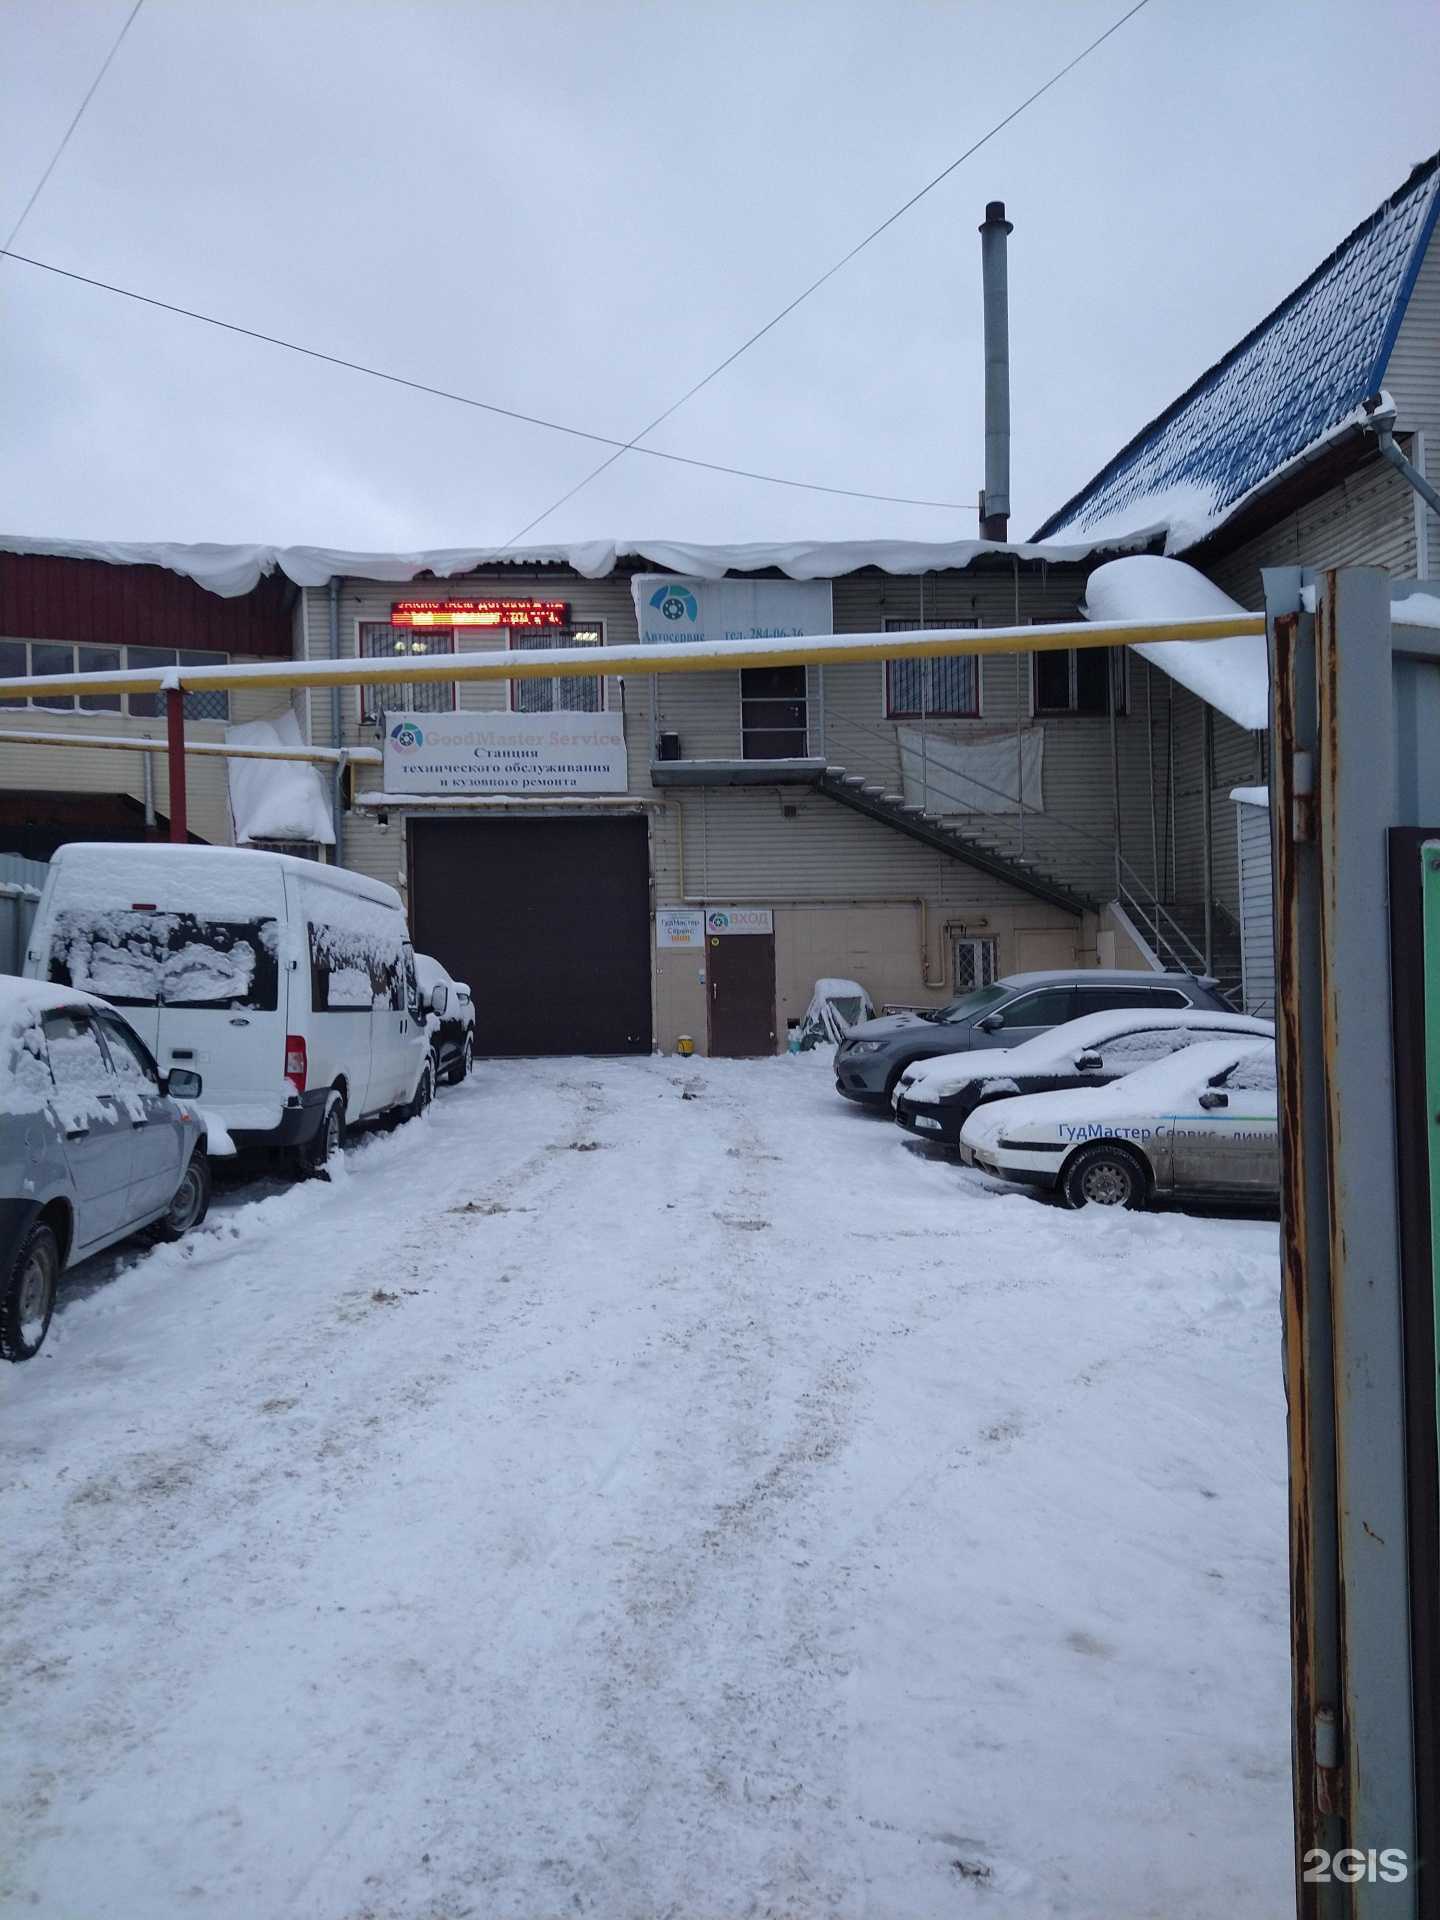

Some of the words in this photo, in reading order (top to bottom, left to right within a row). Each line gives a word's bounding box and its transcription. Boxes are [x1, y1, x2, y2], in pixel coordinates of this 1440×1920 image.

[644, 631, 705, 643] Автосервис
[426, 731, 544, 746] GoodMaster
[549, 731, 622, 746] Service
[474, 747, 539, 760] Станция
[402, 764, 501, 774] технического
[504, 762, 611, 776] обслуживания
[440, 779, 449, 787] и
[452, 779, 519, 789] кузовного
[522, 779, 577, 789] ремонта
[1058, 1124, 1151, 1144] ГудМастер
